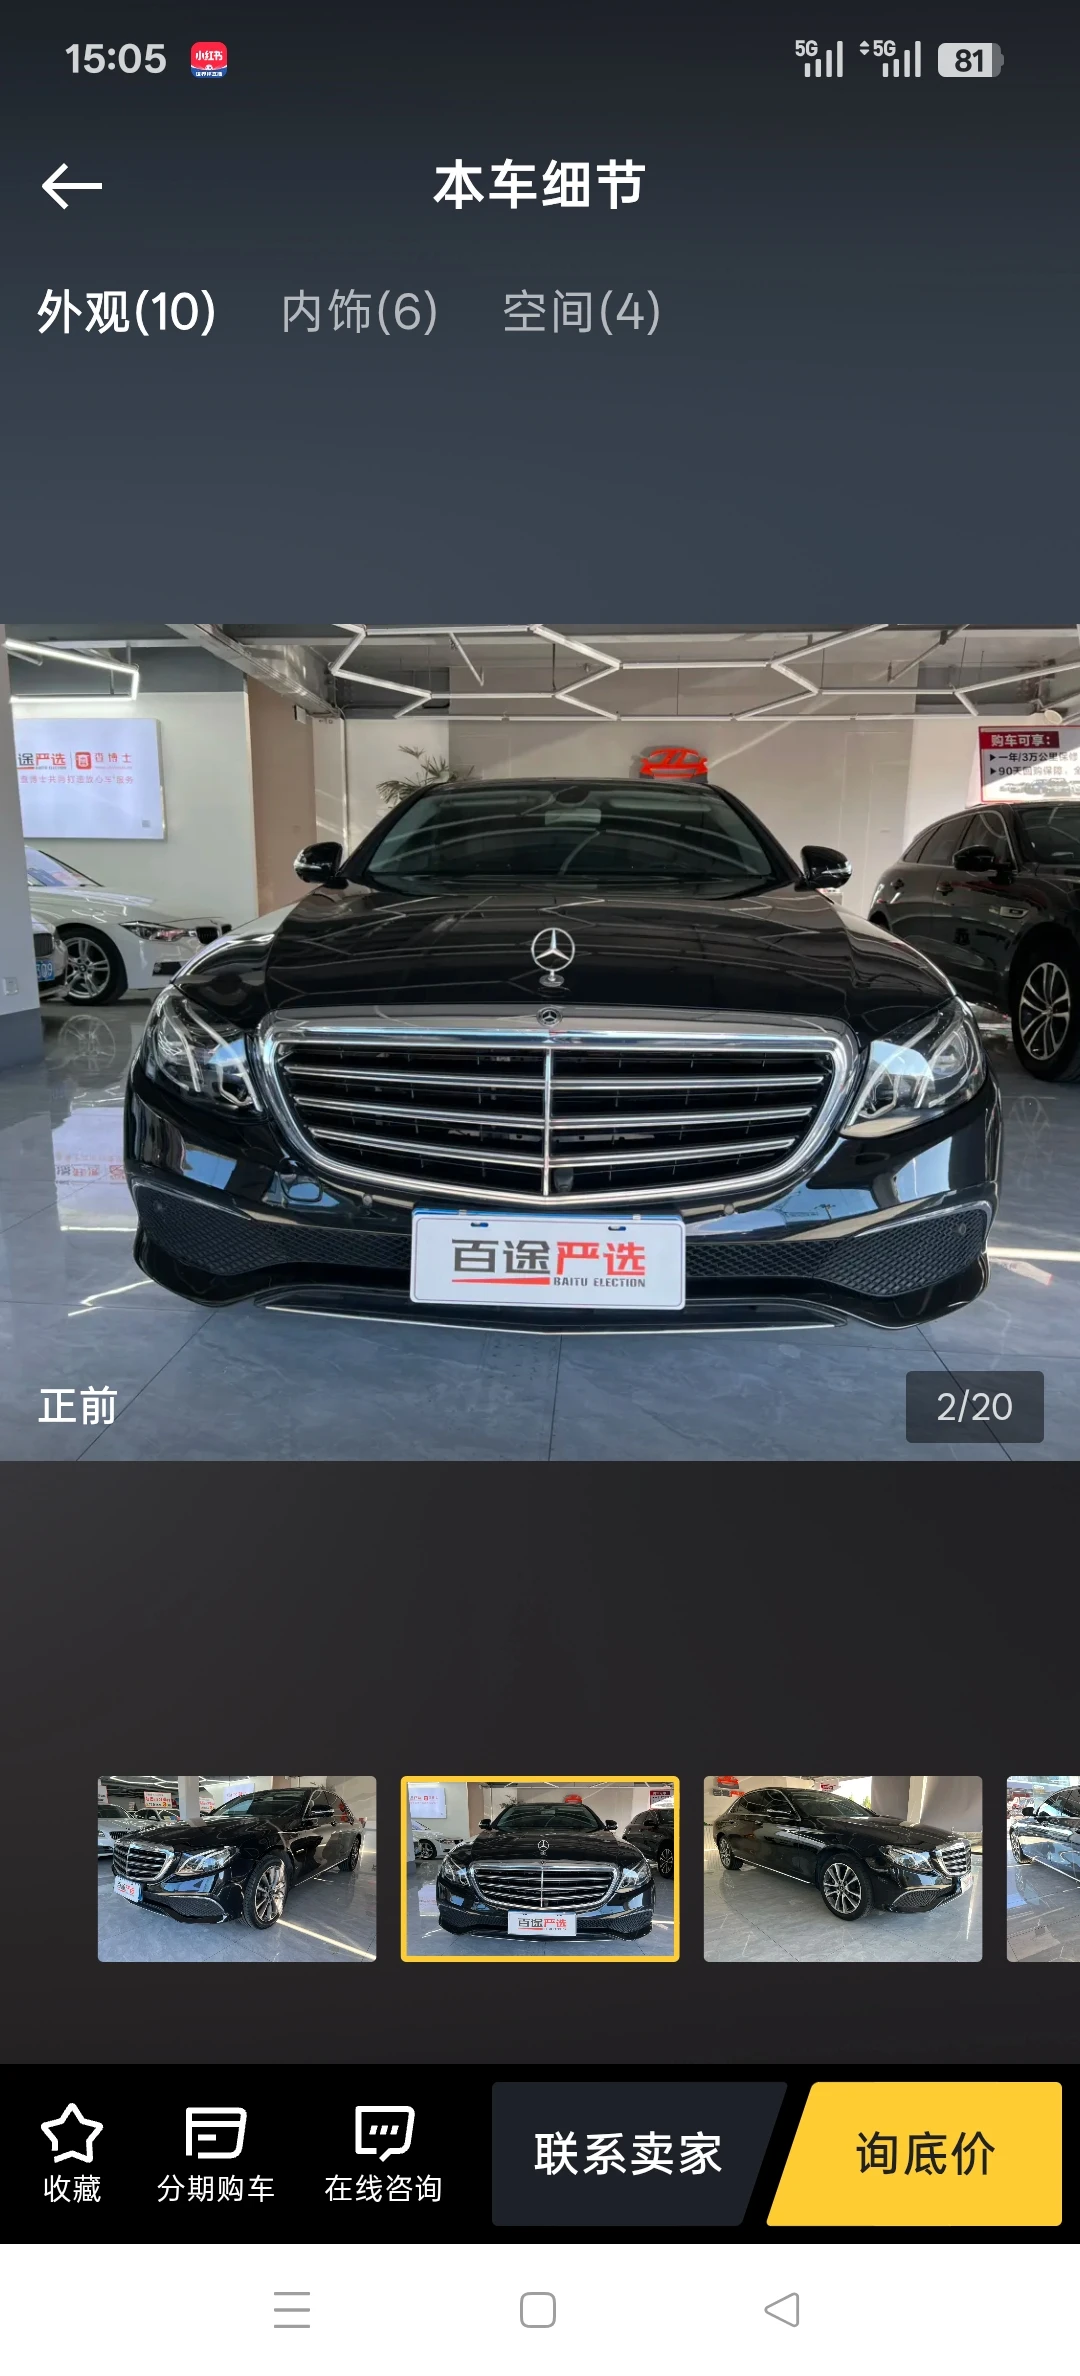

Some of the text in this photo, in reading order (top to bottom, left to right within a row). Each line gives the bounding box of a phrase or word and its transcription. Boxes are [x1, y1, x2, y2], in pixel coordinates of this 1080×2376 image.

[65, 43, 167, 74] 15:05
[195, 50, 223, 61] 小红书
[795, 39, 819, 57] 5G
[873, 39, 897, 57] 5G
[954, 48, 984, 73] 81
[432, 157, 646, 210] 本车细节
[36, 288, 216, 337] 外观(10)
[281, 288, 439, 337] 内饰(6)
[502, 288, 661, 337] 空间(4)
[991, 734, 1051, 747] 购车可享：
[451, 1238, 646, 1276] 百途严选
[553, 1276, 646, 1288] BAITU ELECTION
[533, 2130, 723, 2176] 联系卖家
[856, 2130, 996, 2176] 询底价
[43, 2173, 102, 2204] 收藏
[156, 2173, 276, 2204] 分期购车
[324, 2173, 442, 2204] 在线咨询
